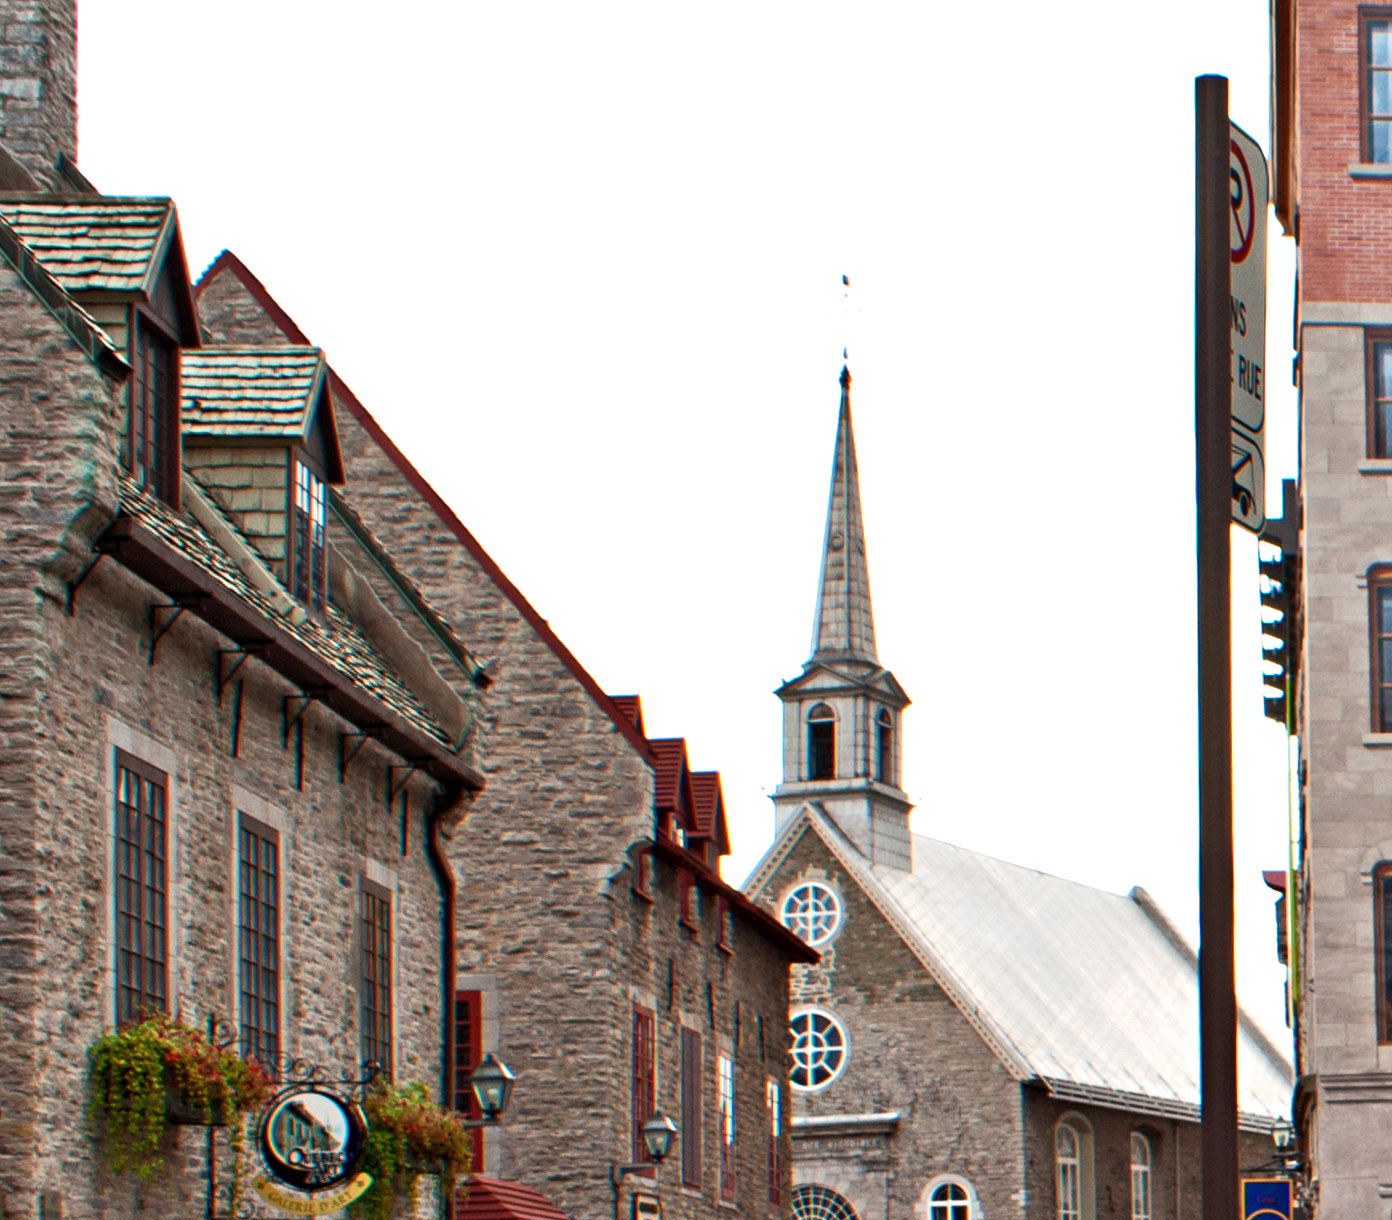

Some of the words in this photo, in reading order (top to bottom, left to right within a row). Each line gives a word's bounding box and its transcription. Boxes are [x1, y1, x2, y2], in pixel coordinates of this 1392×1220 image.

[1230, 294, 1247, 338] NS
[1238, 353, 1262, 402] RUE
[267, 1191, 315, 1213] GALERIE
